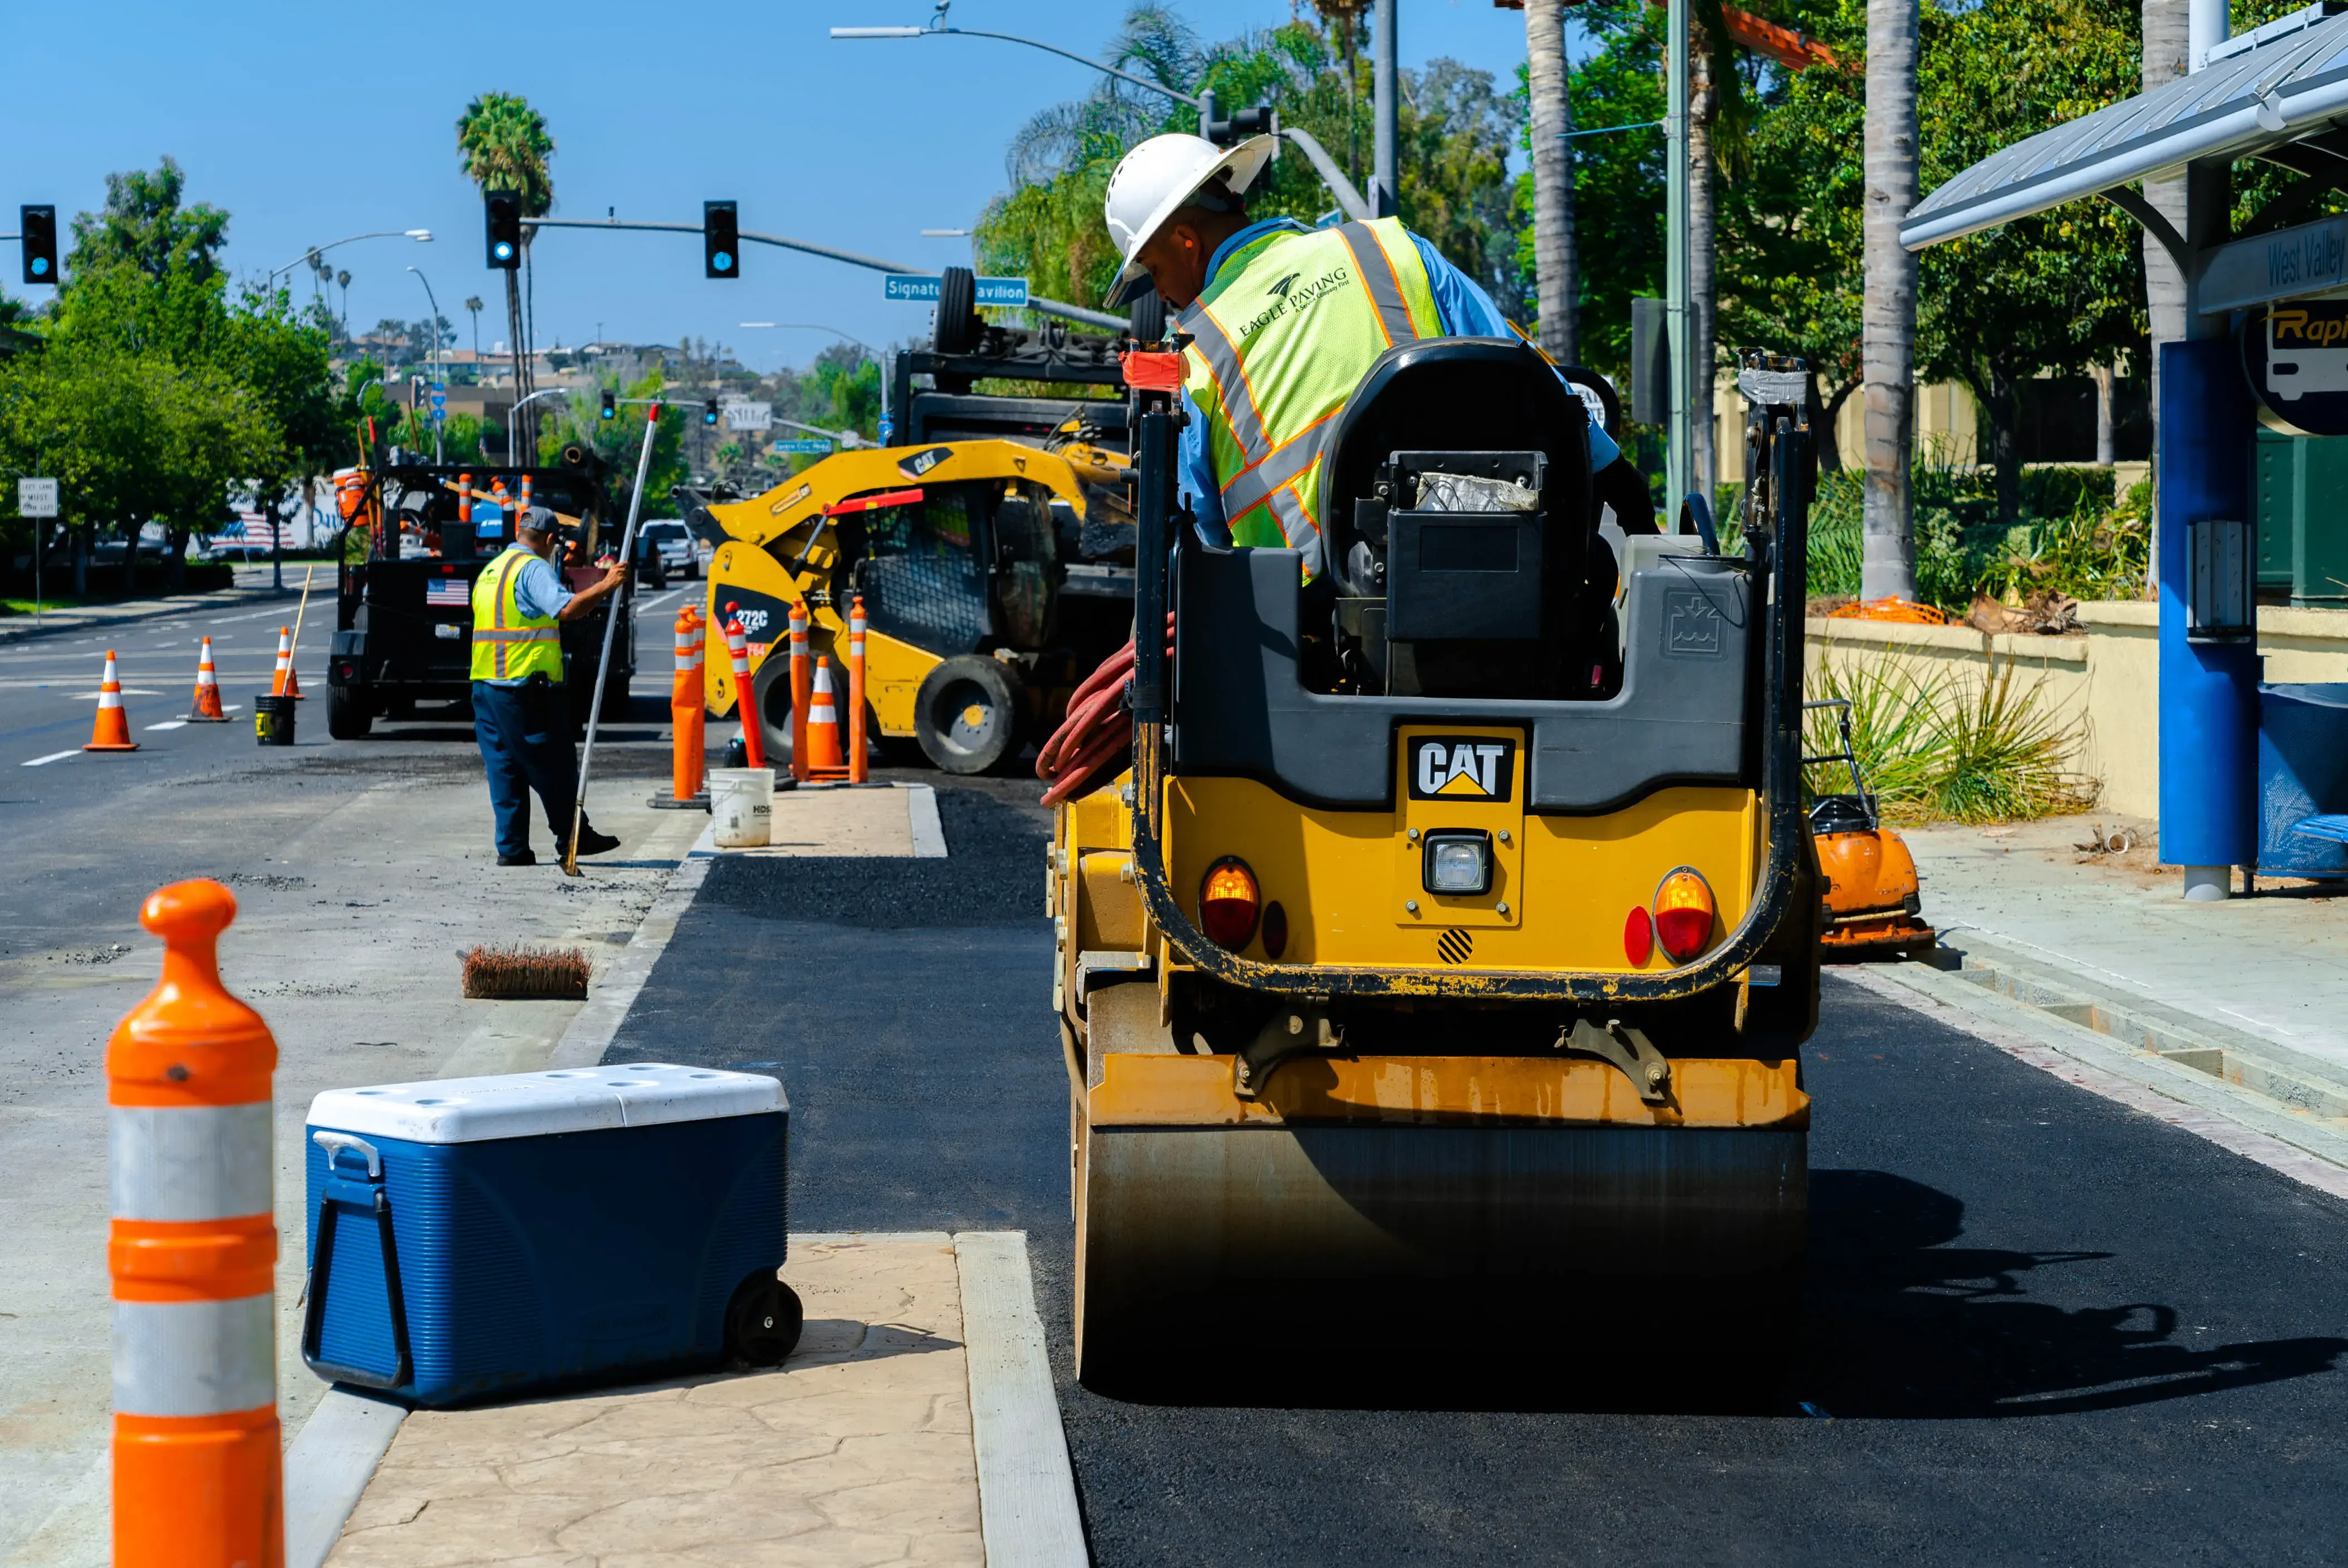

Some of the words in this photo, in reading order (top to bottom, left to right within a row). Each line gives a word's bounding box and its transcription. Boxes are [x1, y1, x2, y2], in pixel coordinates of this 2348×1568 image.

[2268, 240, 2301, 287] West
[2305, 229, 2345, 284] Valley
[888, 281, 941, 299] Signatu
[977, 286, 1024, 298] avilion
[1239, 303, 1288, 336] EAGLE
[1289, 267, 1347, 307] PAVING
[1316, 286, 1338, 299] Company
[914, 450, 936, 474] CAT
[736, 609, 768, 627] 272C
[1419, 743, 1504, 795] CAT
